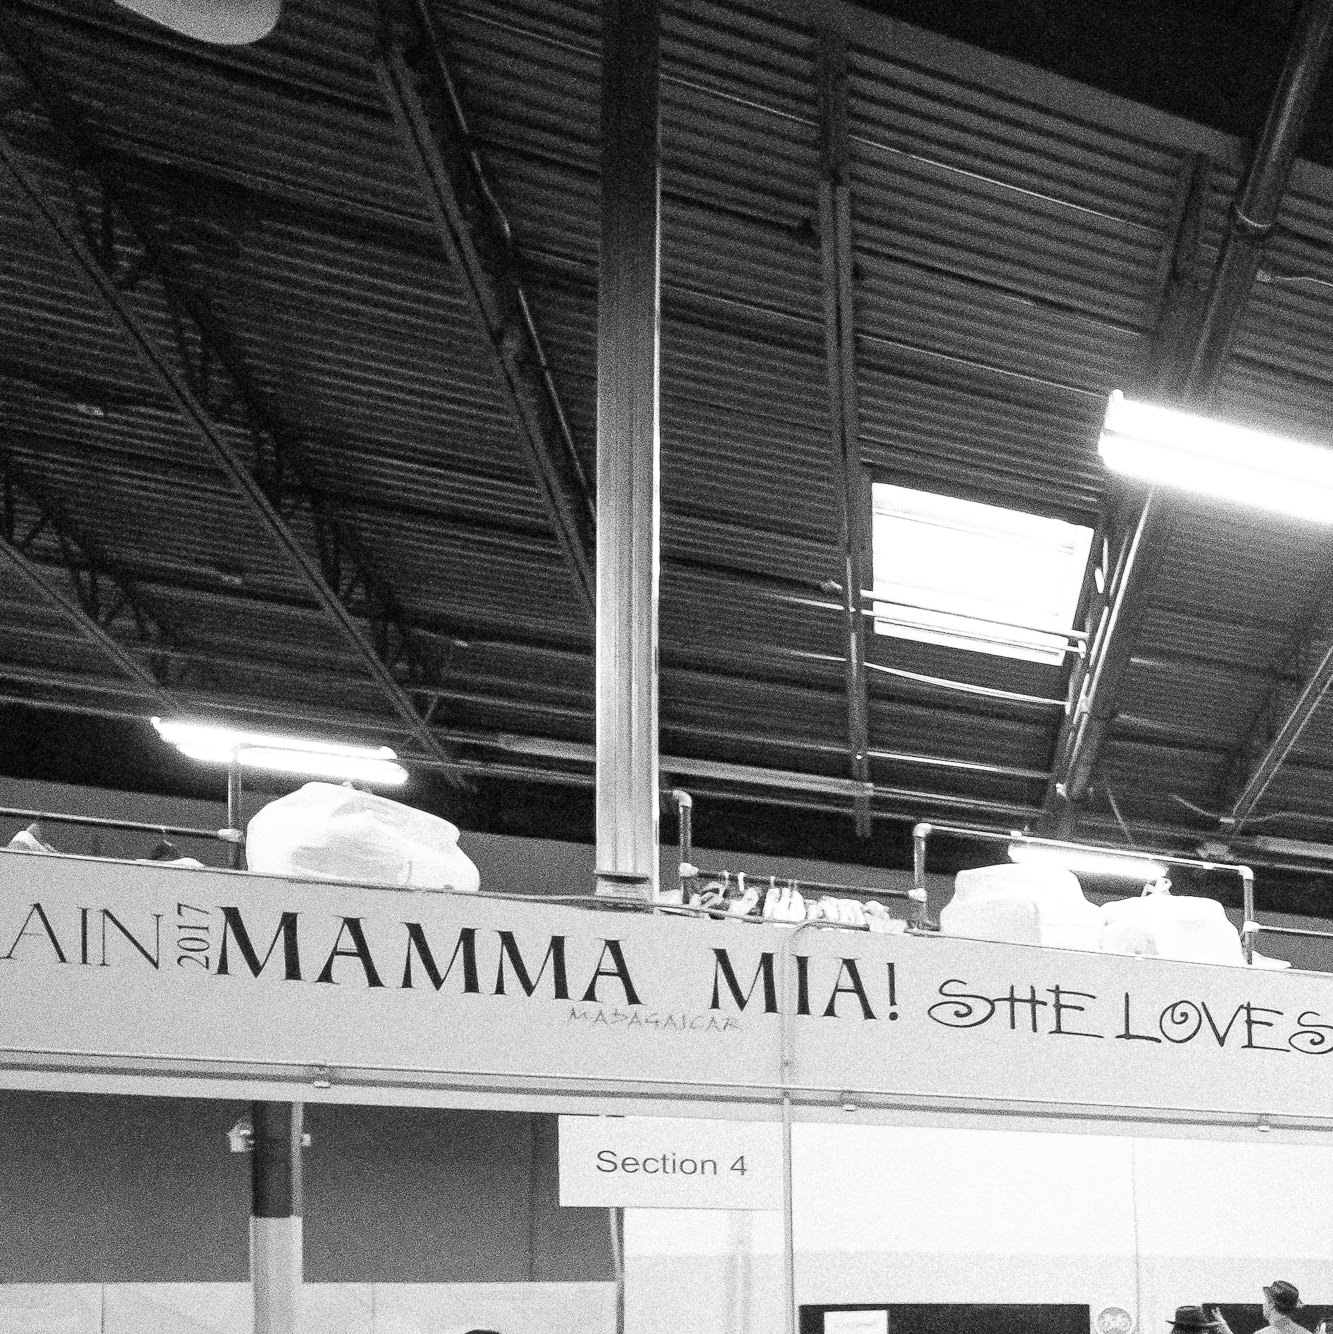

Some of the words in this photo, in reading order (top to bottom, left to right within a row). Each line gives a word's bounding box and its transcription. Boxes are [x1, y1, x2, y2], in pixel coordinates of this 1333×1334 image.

[0, 903, 163, 970] AIN
[177, 902, 210, 970] 2017
[213, 905, 643, 1006] MAMMA
[708, 948, 899, 1021] MIA!
[927, 979, 1104, 1038] SHE
[595, 1149, 718, 1177] Section
[729, 1154, 748, 1177] 4
